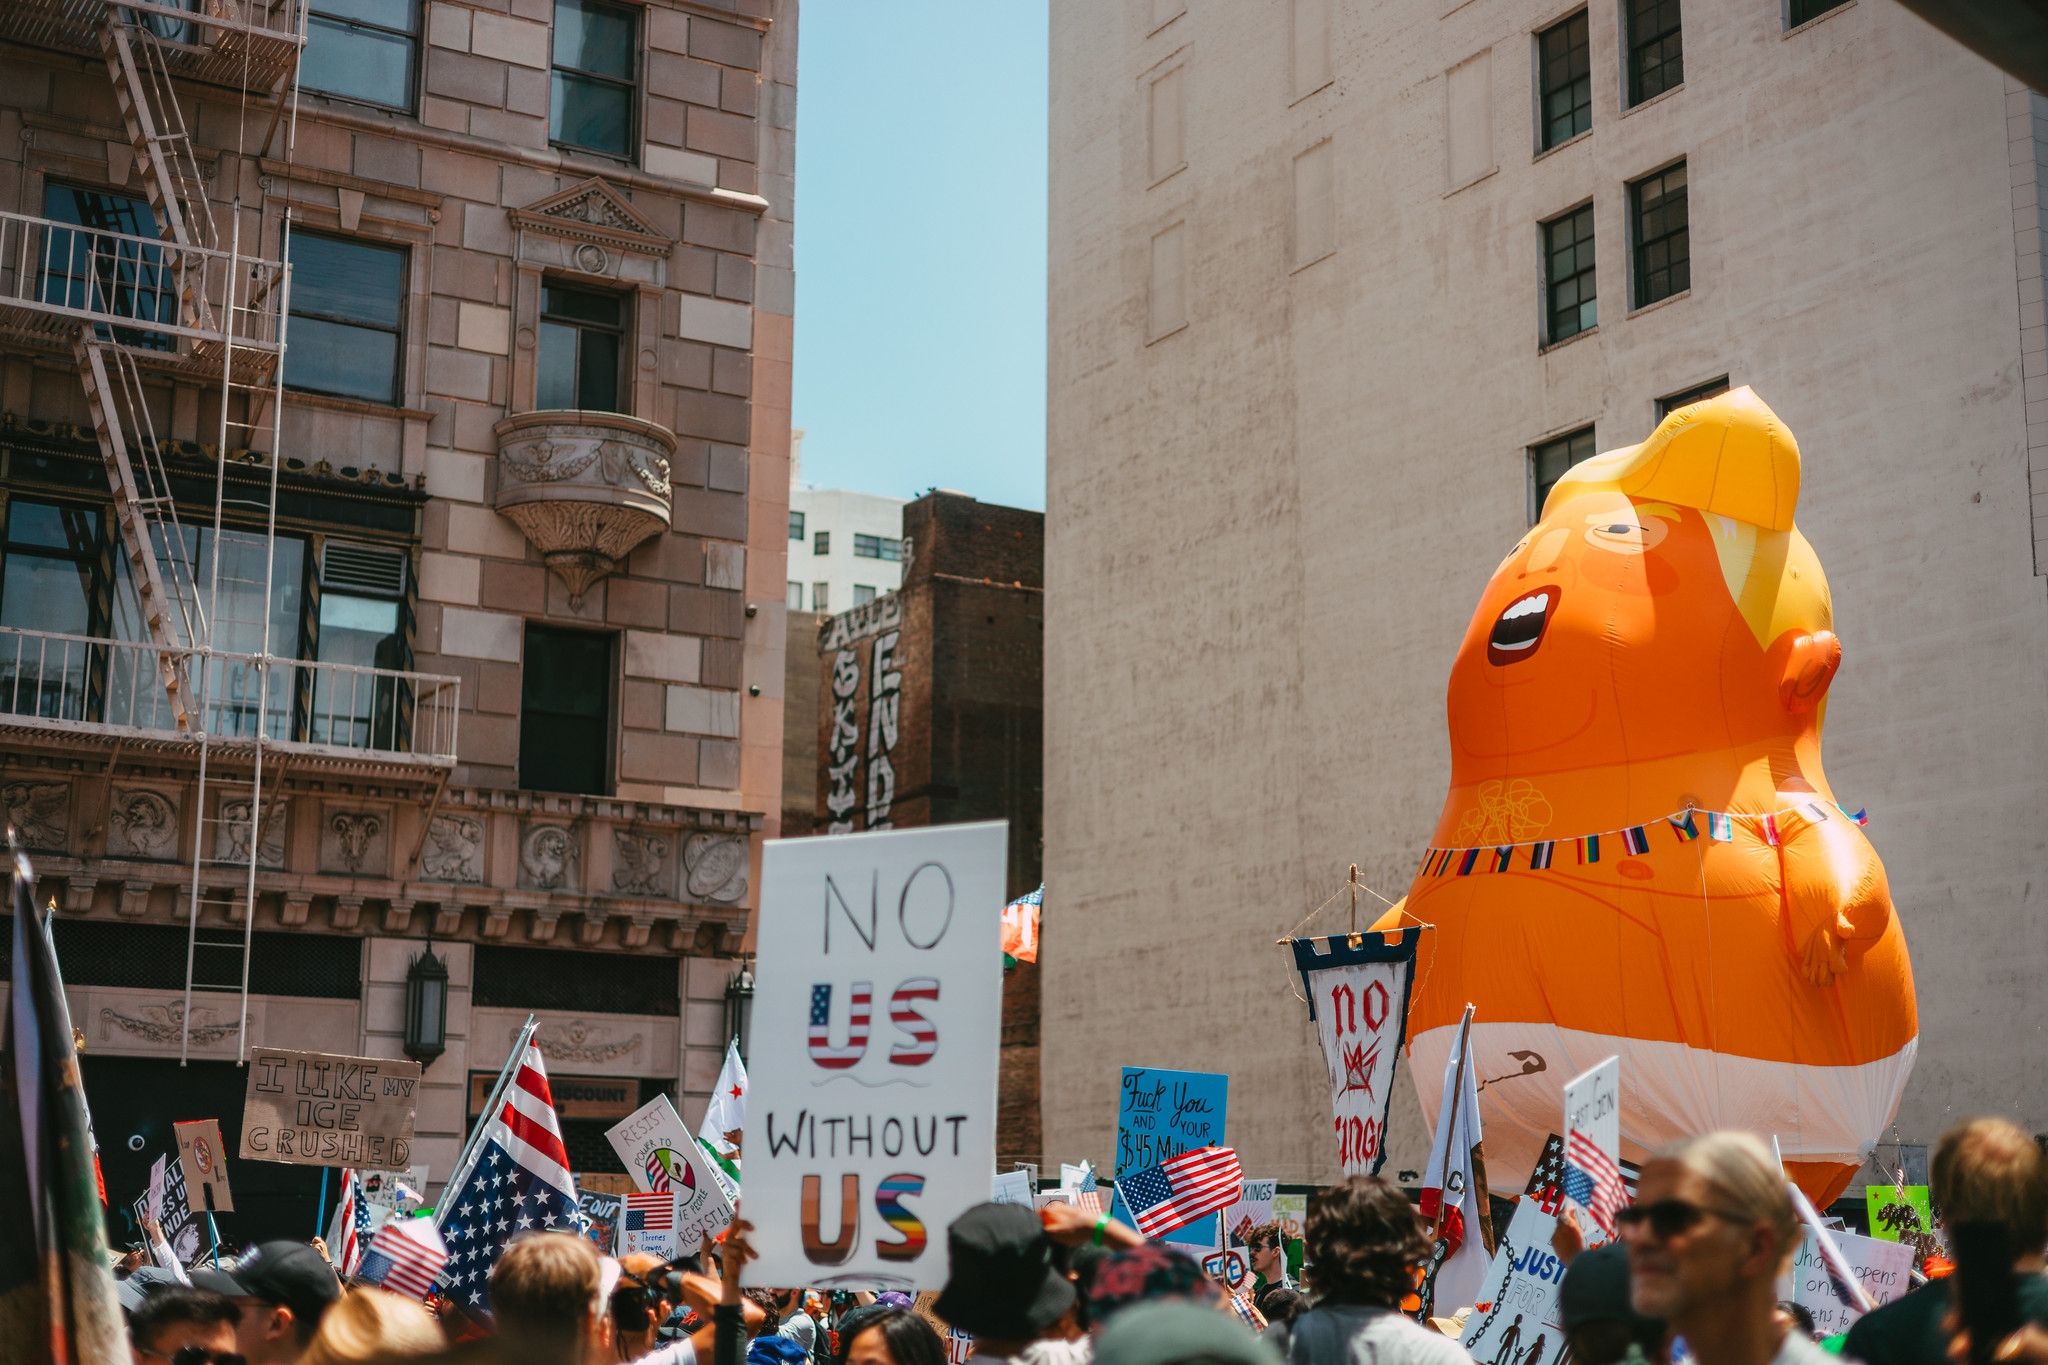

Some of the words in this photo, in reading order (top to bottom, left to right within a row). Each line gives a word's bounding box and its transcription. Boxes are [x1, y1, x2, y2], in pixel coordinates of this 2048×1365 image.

[823, 860, 955, 954] NO
[807, 976, 941, 1070] US
[256, 1057, 287, 1094] I
[295, 1060, 378, 1101] LIKE
[382, 1077, 415, 1098] MY
[296, 1100, 361, 1131] ICE
[1123, 1071, 1167, 1113] Fuck
[1170, 1081, 1214, 1128] You
[619, 1105, 667, 1147] RESIST
[766, 1109, 968, 1158] WITHOUT
[1132, 1115, 1156, 1130] AND
[1180, 1120, 1211, 1138] YOUR
[248, 1126, 410, 1166] CRUSHED
[634, 1139, 657, 1168] POWER
[659, 1137, 672, 1147] TO
[590, 1199, 621, 1218] OUT
[690, 1187, 709, 1215] PEOPLE
[1241, 1183, 1272, 1201] KINGS
[627, 1232, 636, 1242] No
[641, 1231, 666, 1242] Thrones
[800, 1173, 928, 1267] US
[627, 1243, 636, 1253] No
[1514, 1245, 1567, 1285] JUST
[1507, 1277, 1546, 1316] FOR
